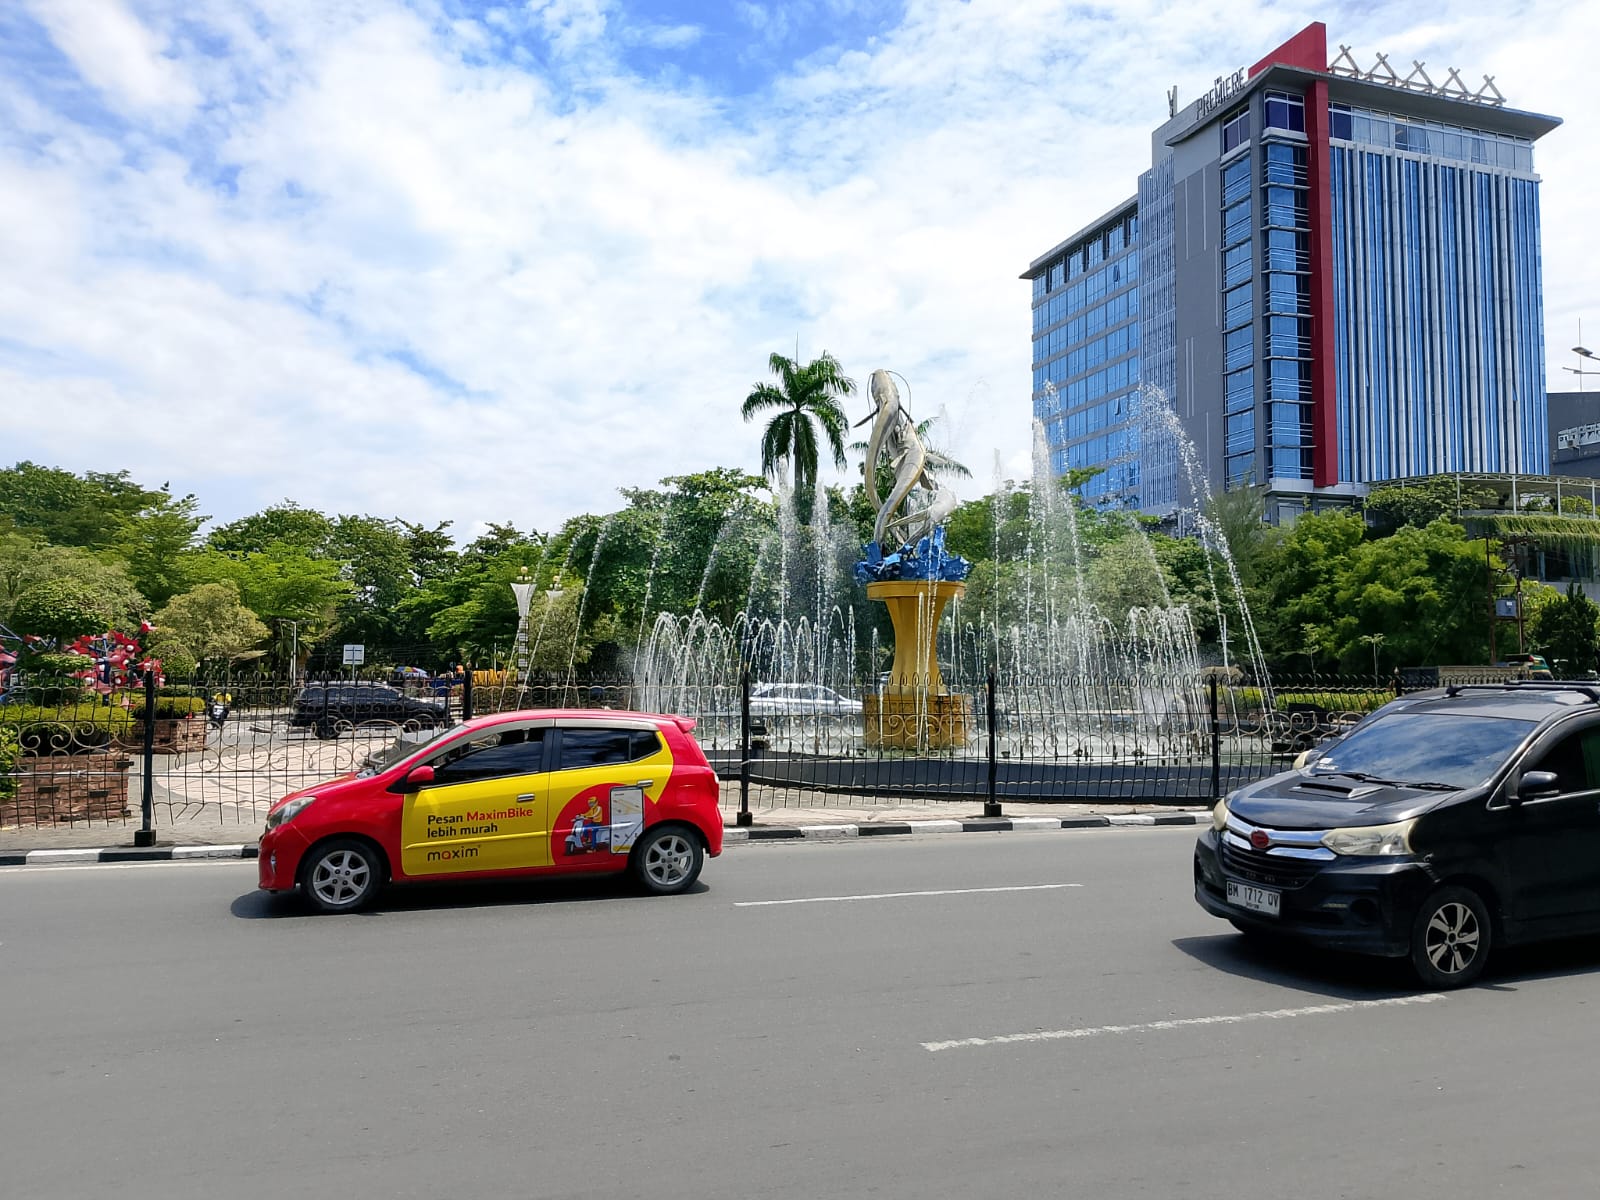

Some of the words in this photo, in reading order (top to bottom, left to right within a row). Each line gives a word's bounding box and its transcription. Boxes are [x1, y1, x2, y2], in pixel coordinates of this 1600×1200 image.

[1196, 67, 1245, 120] PREMIERE
[427, 815, 463, 825] Pesan
[466, 808, 533, 822] MaximBike
[427, 826, 457, 838] lebih
[460, 823, 498, 835] murah
[427, 846, 479, 862] maxim
[1227, 883, 1239, 897] BM
[1244, 887, 1263, 904] 1712
